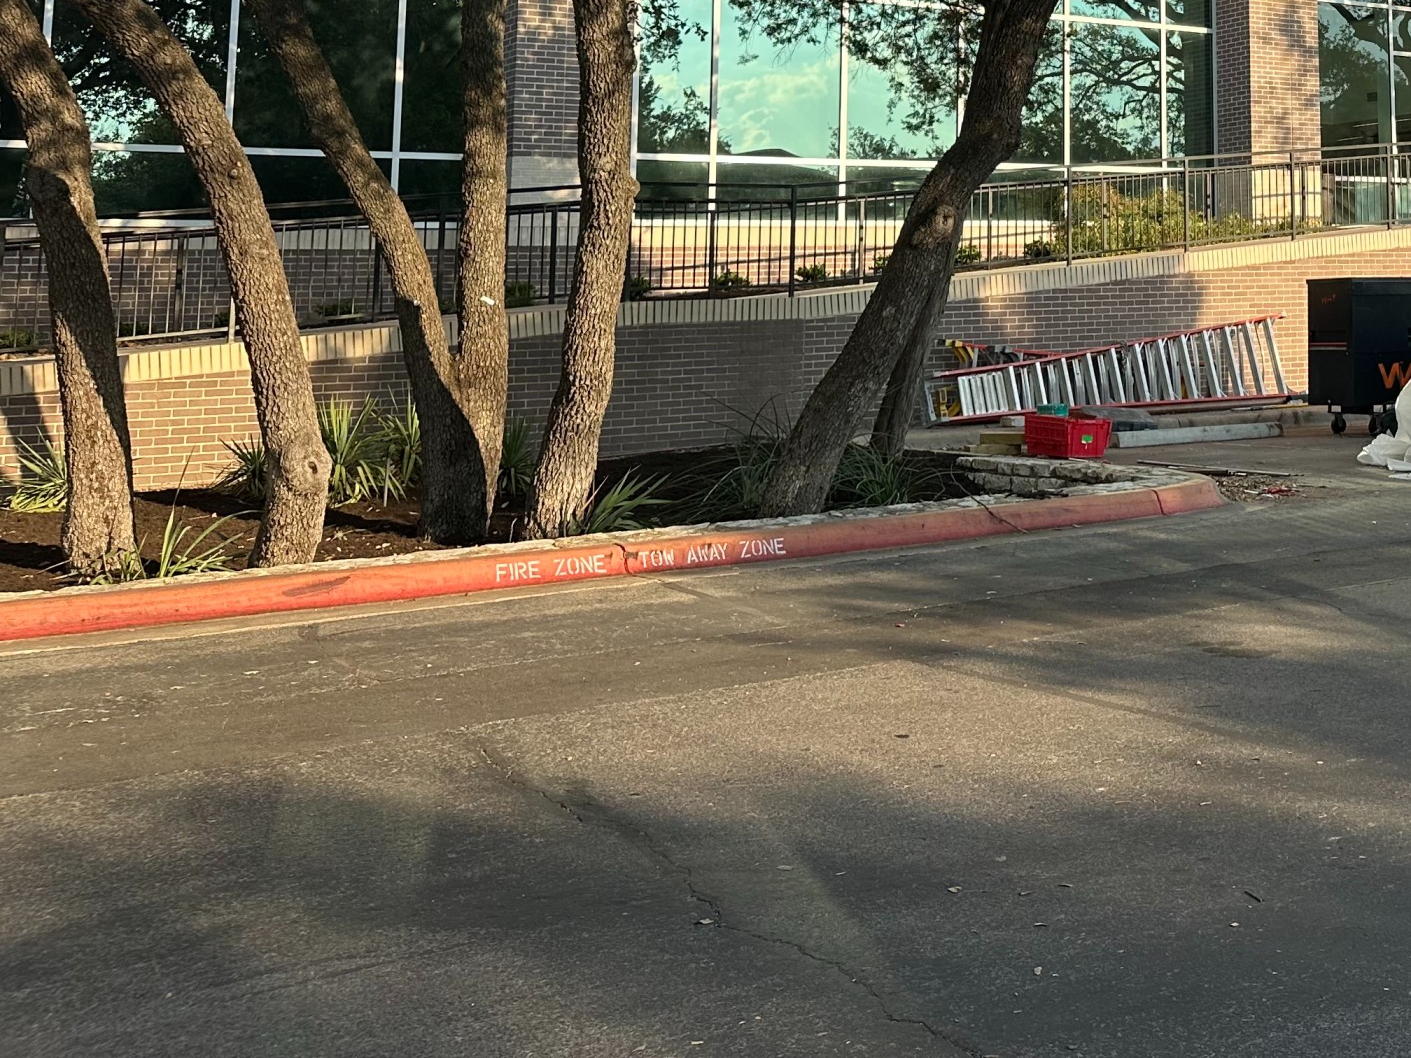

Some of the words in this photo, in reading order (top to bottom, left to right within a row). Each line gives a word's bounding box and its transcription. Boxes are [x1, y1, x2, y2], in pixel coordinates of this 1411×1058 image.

[495, 560, 541, 582] FIRE
[553, 553, 607, 576] ZONE
[638, 550, 675, 568] TOW
[687, 542, 728, 564] AWAY
[739, 537, 786, 559] ZONE
